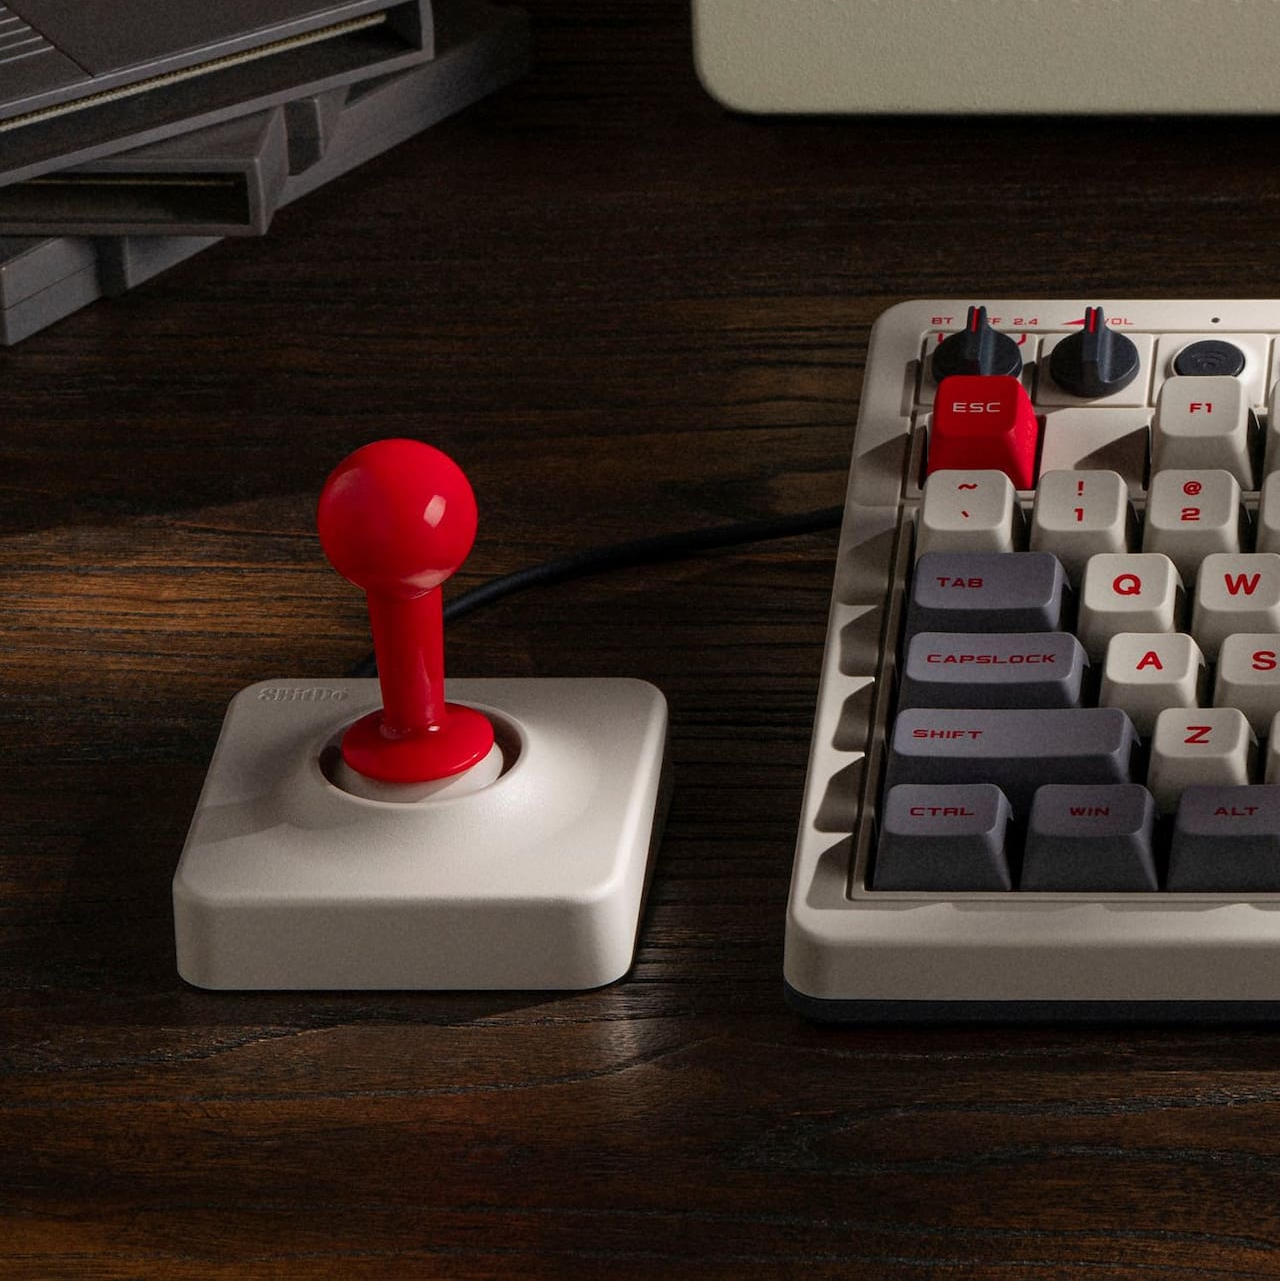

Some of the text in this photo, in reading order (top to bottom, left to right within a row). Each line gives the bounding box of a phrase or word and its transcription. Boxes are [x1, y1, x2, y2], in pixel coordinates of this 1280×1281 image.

[931, 317, 954, 325] BT
[1014, 318, 1038, 326] 2.4
[952, 402, 1001, 413] ESC
[1189, 402, 1213, 413] F1
[1077, 480, 1085, 495] !
[1183, 481, 1201, 496] @
[1075, 507, 1084, 521] 1
[1181, 508, 1200, 521] 2
[936, 577, 984, 589] TAB
[1113, 574, 1141, 595] Q
[1225, 574, 1260, 595] W
[927, 654, 1053, 665] CAPSLOCK
[1136, 651, 1163, 671] A
[1252, 651, 1276, 670] S
[913, 729, 982, 740] SHIFT
[1185, 725, 1211, 744] Z
[909, 806, 975, 817] CTRL
[1069, 806, 1110, 816] WIN
[1215, 806, 1256, 817] ALT
